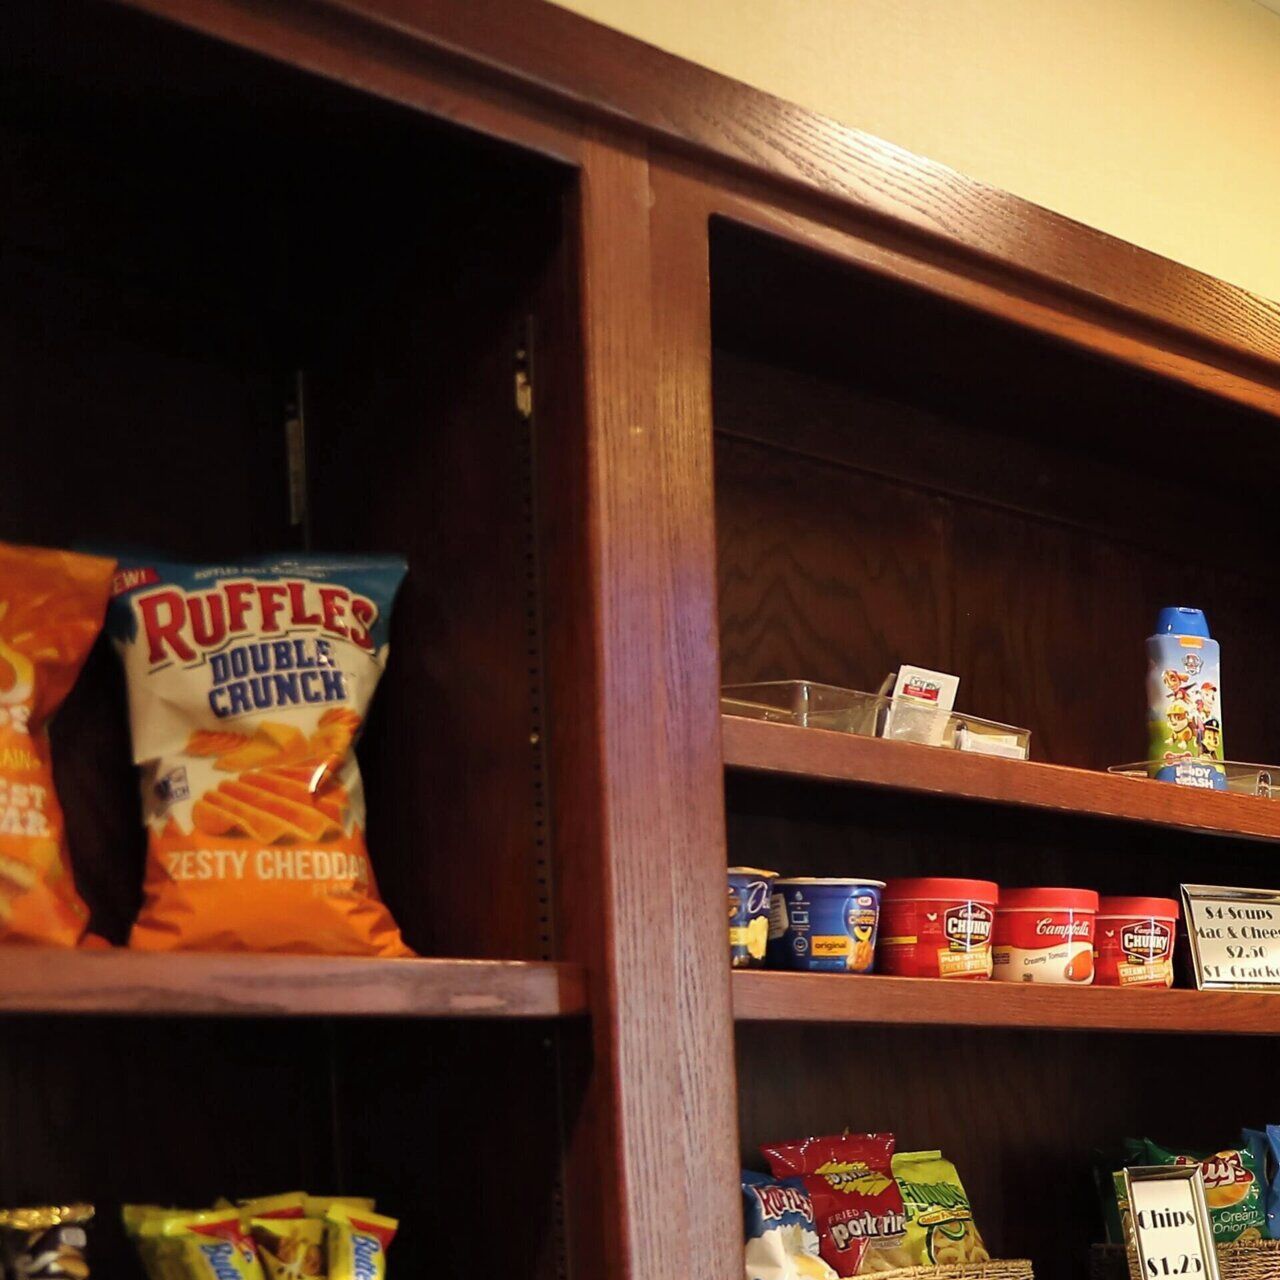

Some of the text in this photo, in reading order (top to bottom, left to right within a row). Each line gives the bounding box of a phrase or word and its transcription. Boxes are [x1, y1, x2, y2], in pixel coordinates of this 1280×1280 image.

[139, 581, 376, 664] RUFFLES
[210, 640, 335, 686] DOUBLE
[208, 672, 346, 718] CRUNCH
[167, 849, 248, 881] ZESTY
[1227, 926, 1238, 939] &
[1024, 955, 1046, 966] Creamy
[1226, 945, 1267, 958] $2.50
[828, 1209, 860, 1224] FRIED
[1138, 1207, 1195, 1230] Chips
[1213, 1222, 1247, 1234] Onion
[1220, 1210, 1257, 1223] Cream
[831, 1211, 877, 1249] pork
[1147, 1254, 1203, 1278] $1.25
